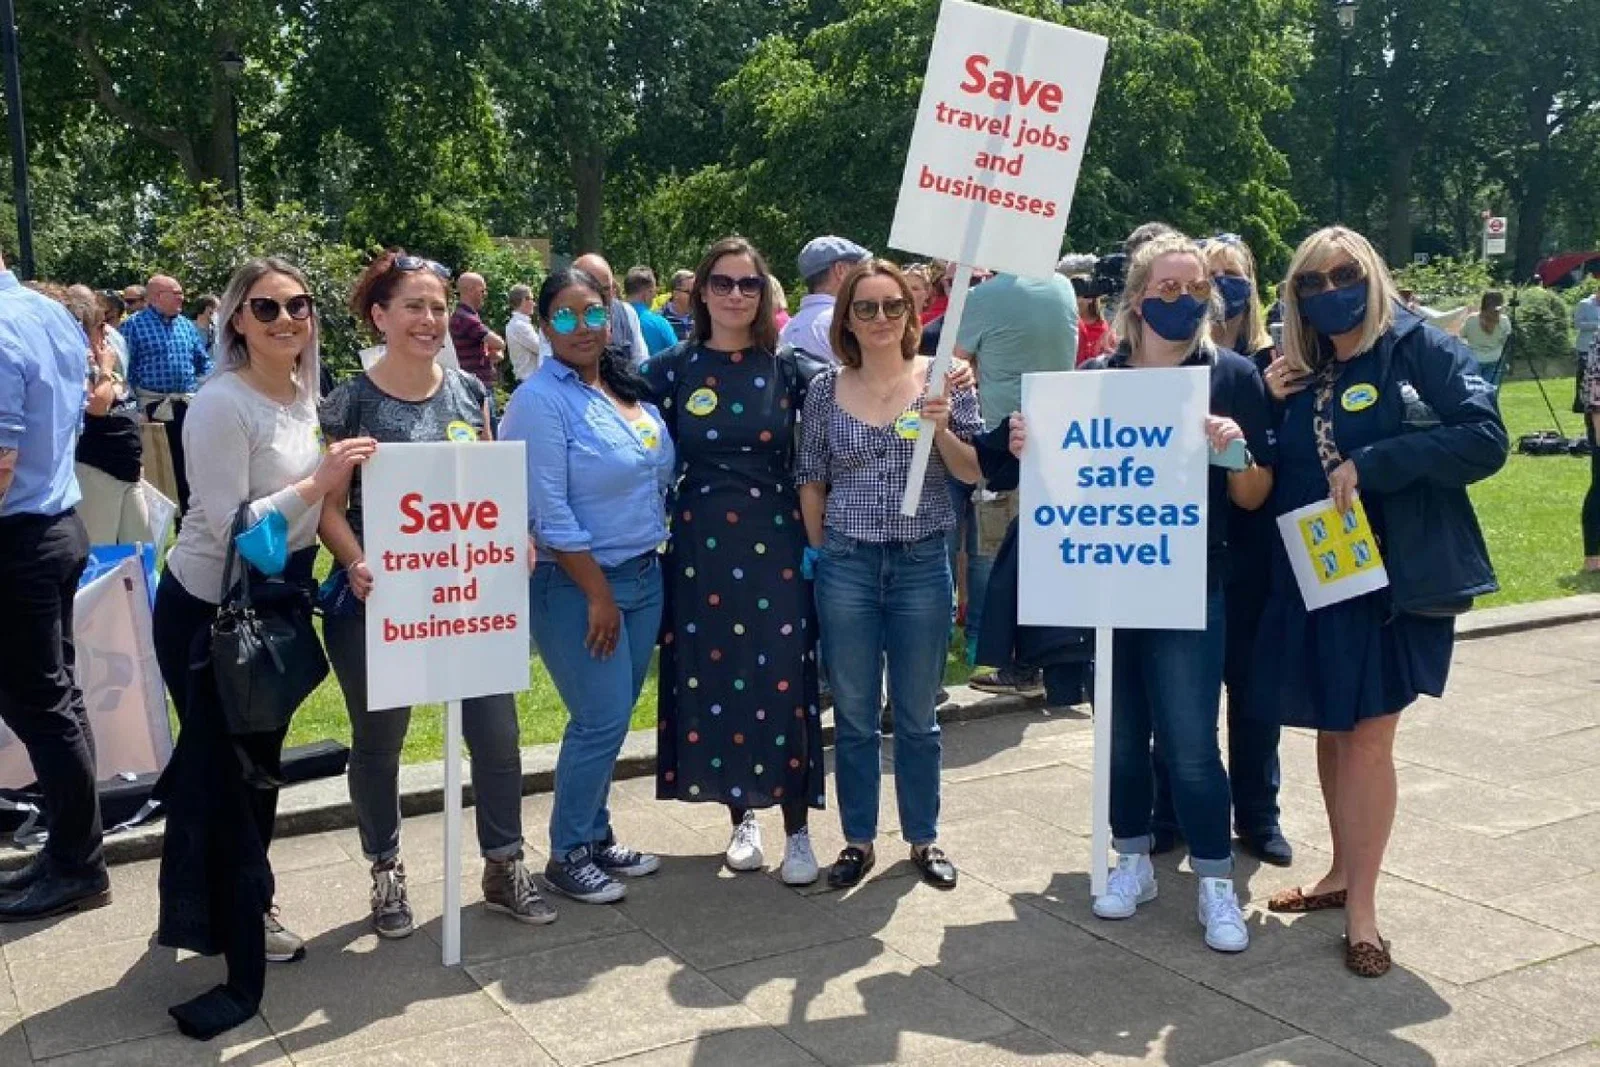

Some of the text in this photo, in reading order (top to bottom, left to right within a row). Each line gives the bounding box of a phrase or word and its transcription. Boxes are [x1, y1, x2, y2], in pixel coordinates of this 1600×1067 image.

[962, 54, 1063, 114] Save
[936, 100, 1071, 154] travel jobs
[975, 151, 1024, 177] and
[919, 168, 1057, 218] businesses
[1062, 418, 1173, 449] Allow
[1077, 454, 1156, 489] safe
[399, 493, 500, 535] Save
[1033, 501, 1201, 529] overseas
[383, 541, 516, 573] travel jobs
[1060, 536, 1172, 567] travel
[432, 577, 478, 604] and
[383, 612, 517, 642] businesses
